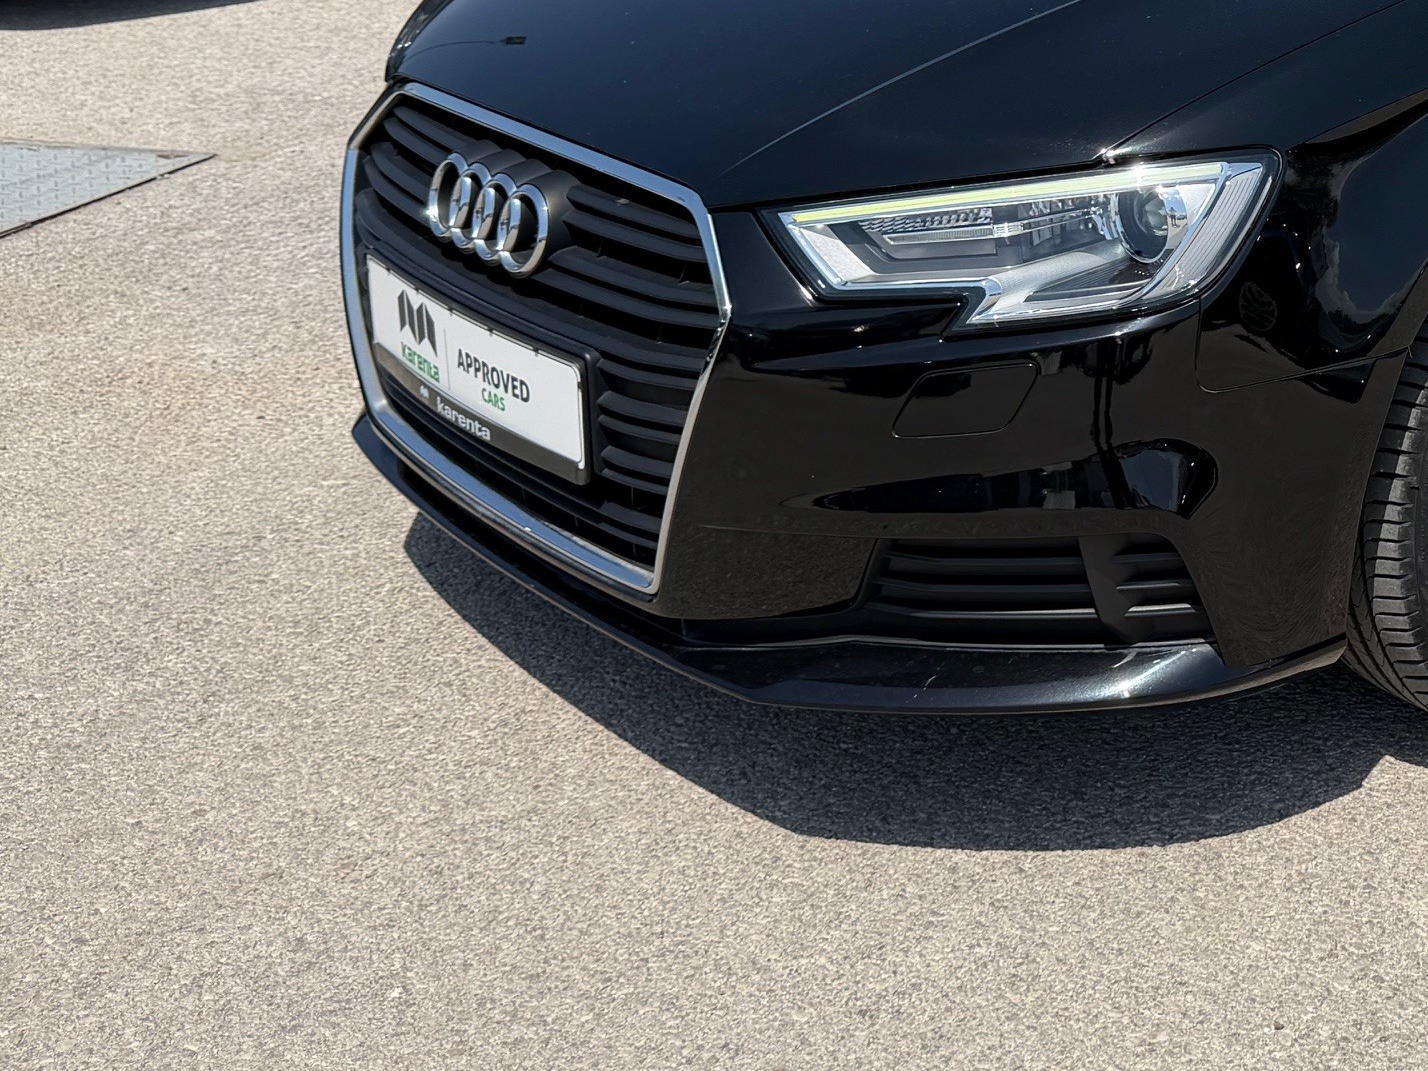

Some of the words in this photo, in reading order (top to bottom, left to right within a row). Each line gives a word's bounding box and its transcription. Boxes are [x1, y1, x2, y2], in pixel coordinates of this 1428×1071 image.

[400, 341, 440, 383] karenta
[457, 348, 530, 403] APPROVED
[436, 395, 491, 441] karenta
[481, 387, 505, 411] CARS
